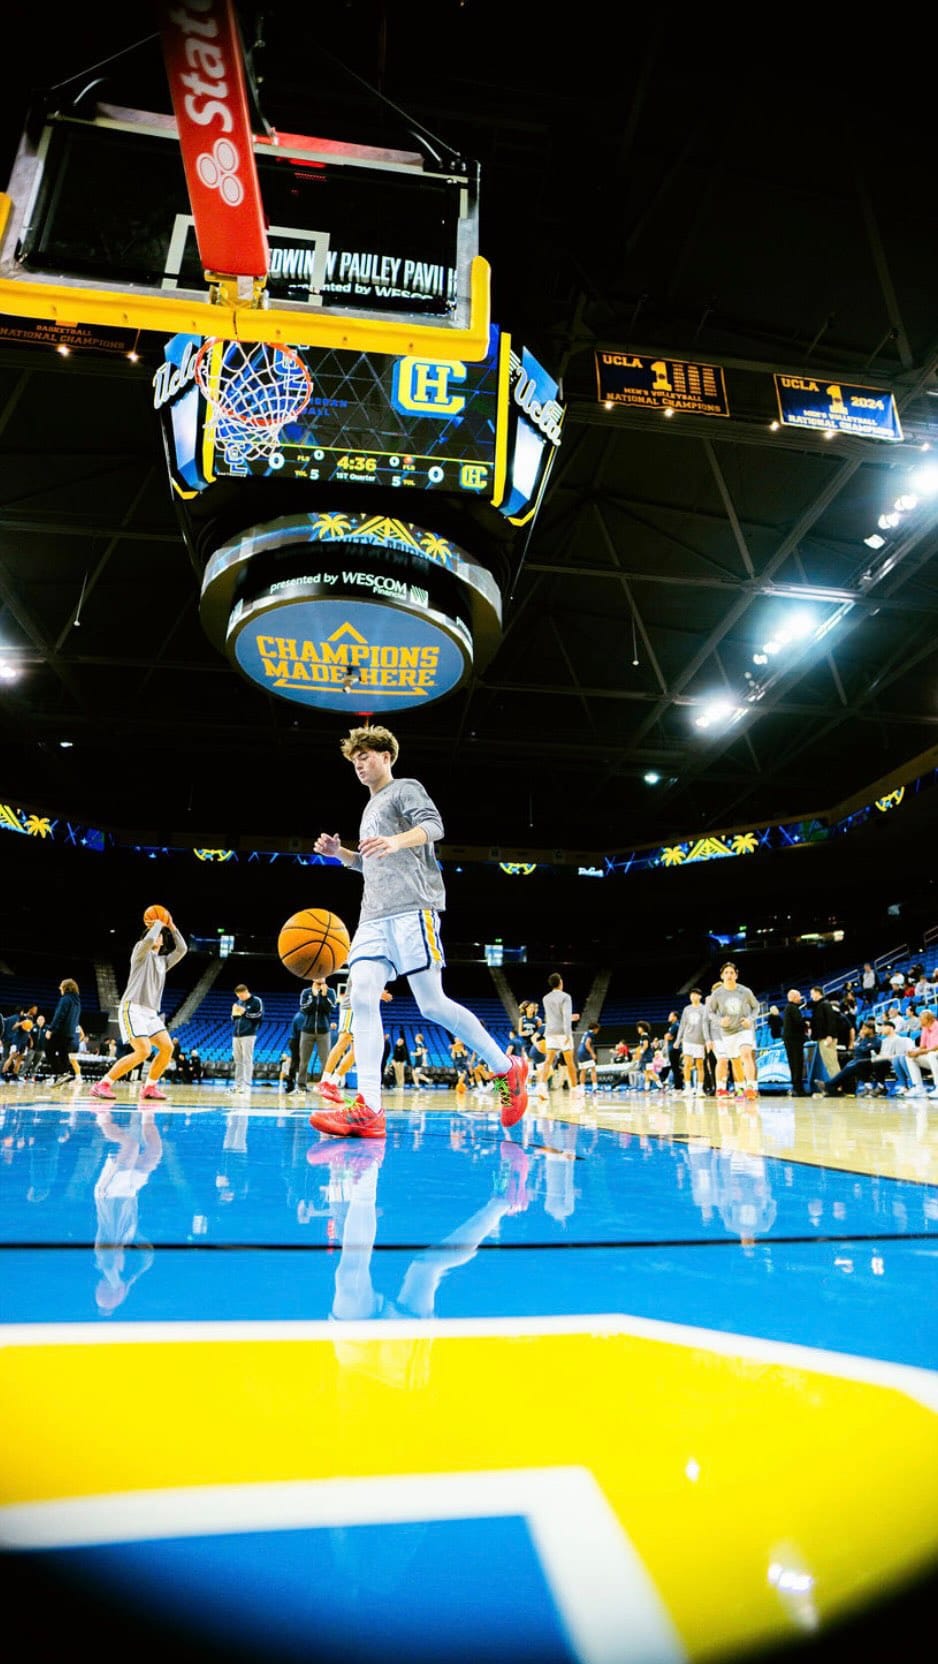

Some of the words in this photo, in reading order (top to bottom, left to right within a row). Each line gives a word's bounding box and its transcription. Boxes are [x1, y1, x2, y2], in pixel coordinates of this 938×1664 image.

[268, 248, 315, 277] DWIN
[339, 252, 401, 286] PAULEY
[602, 354, 643, 369] UCLA
[650, 361, 673, 391] 1
[781, 377, 820, 392] UCLA
[606, 392, 659, 405] NATIONAL
[661, 398, 721, 413] CHAMPIONS
[826, 384, 849, 415] 1
[850, 395, 885, 411] 2024
[268, 452, 285, 469] 0
[313, 449, 325, 461] 0
[337, 455, 377, 472] 4:36
[389, 455, 400, 467] 0
[309, 468, 320, 480] 5
[391, 476, 401, 488] 5
[428, 465, 444, 483] 0
[269, 573, 321, 595] presented
[323, 572, 339, 585] by
[341, 570, 408, 595] WESCOM
[255, 634, 440, 669] CHAMPIONS
[260, 657, 346, 685] MADE
[359, 667, 438, 688] HERE
